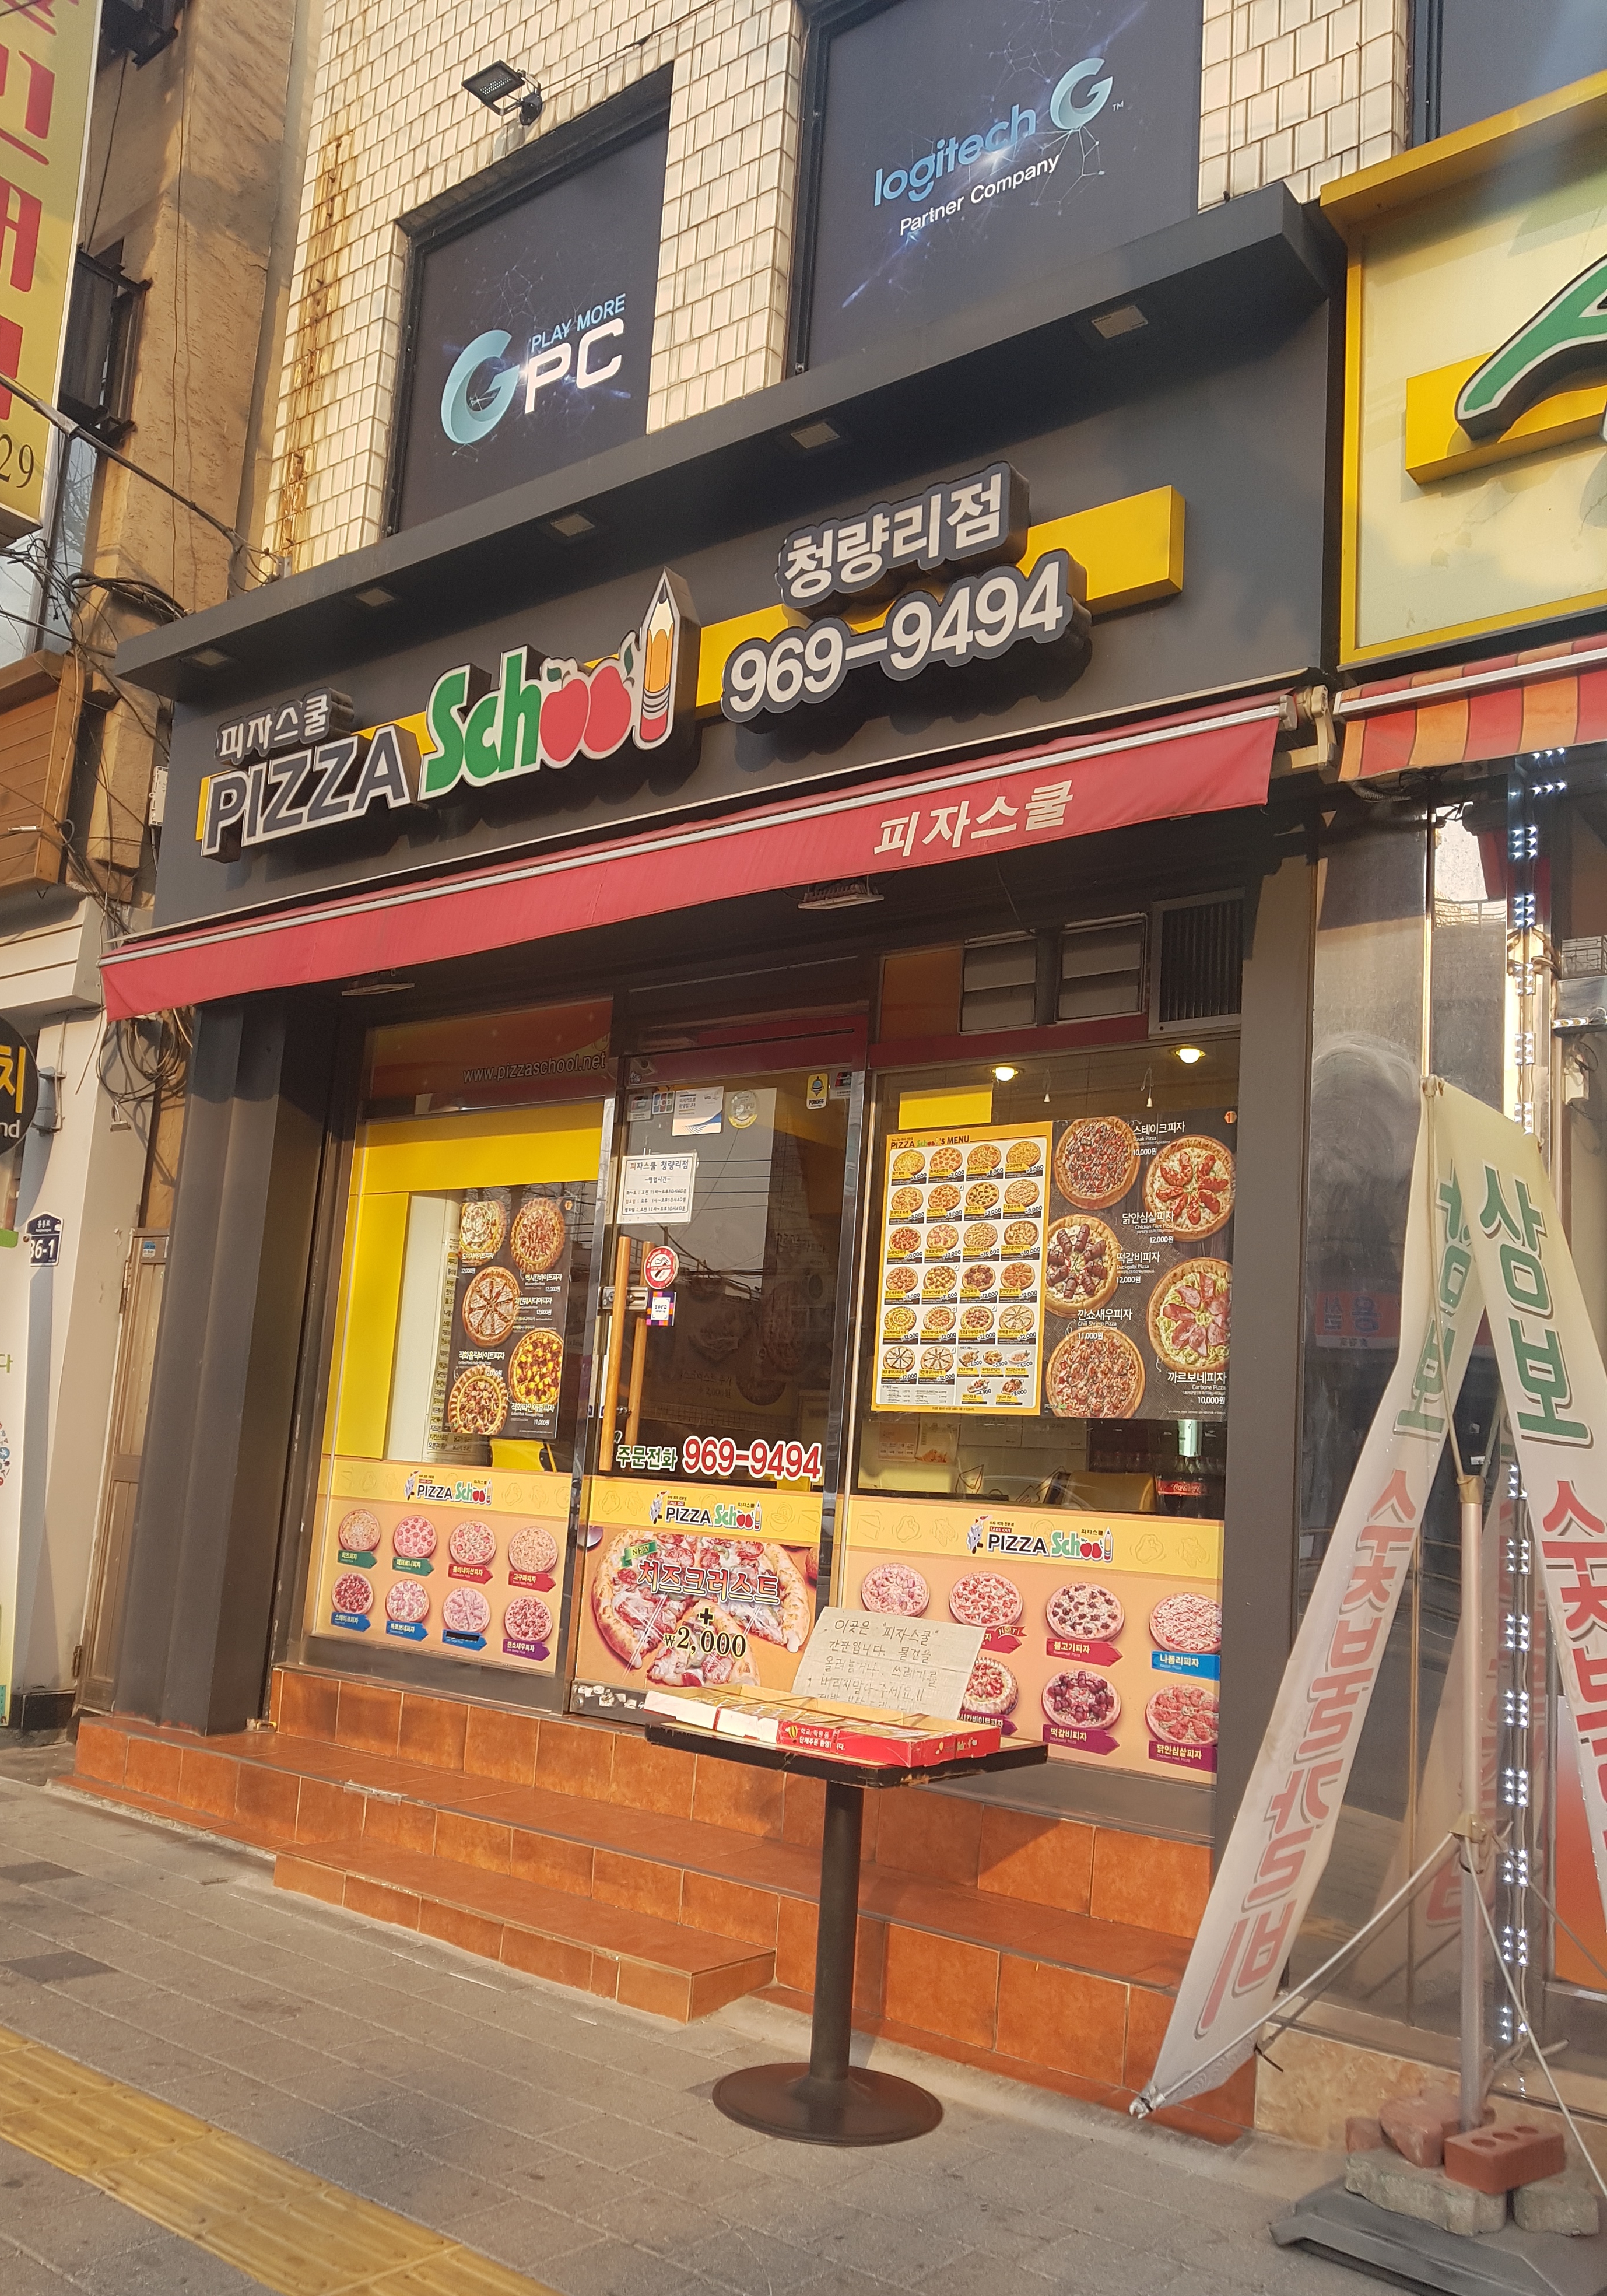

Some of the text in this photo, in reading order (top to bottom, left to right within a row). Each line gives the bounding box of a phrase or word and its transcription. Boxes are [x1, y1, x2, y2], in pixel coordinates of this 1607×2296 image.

[874, 104, 1036, 206] logitech
[900, 154, 1060, 236] Partner Company
[531, 293, 626, 353] PLAY MORE
[525, 318, 624, 414] PC
[784, 472, 1002, 599] 청량리점
[729, 560, 1064, 713] 969-9494
[217, 692, 331, 760] 피자스쿨
[202, 724, 413, 857] PIZZA
[873, 780, 1074, 857] 피자스쿨
[463, 1051, 606, 1084] www.pizzaschool.net
[653, 1098, 672, 1107] JCB
[1132, 1121, 1185, 1135] 스테이크피자
[890, 1141, 915, 1149] PIZZA
[946, 1135, 970, 1145] MENU
[1133, 1148, 1157, 1156] 10,000원
[630, 1159, 689, 1171] 피자스쿨 청량리점
[1122, 1211, 1175, 1225] 닭안심살피자
[1149, 1235, 1174, 1243] 12,000원
[1117, 1251, 1161, 1264] 떡갈비피자
[1117, 1275, 1141, 1284] 12,000원
[1077, 1308, 1133, 1321] 깐쇼새우피자
[1078, 1332, 1103, 1340] 11,000원
[1167, 1371, 1227, 1384] 까르보네피자
[1198, 1396, 1226, 1405] 10,000원
[616, 1445, 677, 1470] 주문전화
[684, 1438, 821, 1480] 969-9494
[417, 1485, 452, 1499] PIZZA
[666, 1507, 711, 1524] PIZZA
[632, 1545, 650, 1556] NEW
[988, 1534, 1047, 1554] PIZZA
[513, 1573, 536, 1583] 고구마피자
[638, 1560, 781, 1604] 치즈크러스트
[834, 1619, 871, 1635] 이곳은
[998, 1626, 1021, 1635] HOT!
[898, 1646, 932, 1664] 물건을
[1054, 1642, 1090, 1654] 불고기피자
[1160, 1654, 1199, 1668] 나폴리피자
[892, 1665, 938, 1688] 쓰레기를
[957, 1713, 1004, 1727] 시칸바이트피자
[1051, 1727, 1087, 1741] 떡갈비피자
[1157, 1744, 1202, 1760] 닭안심살피자
